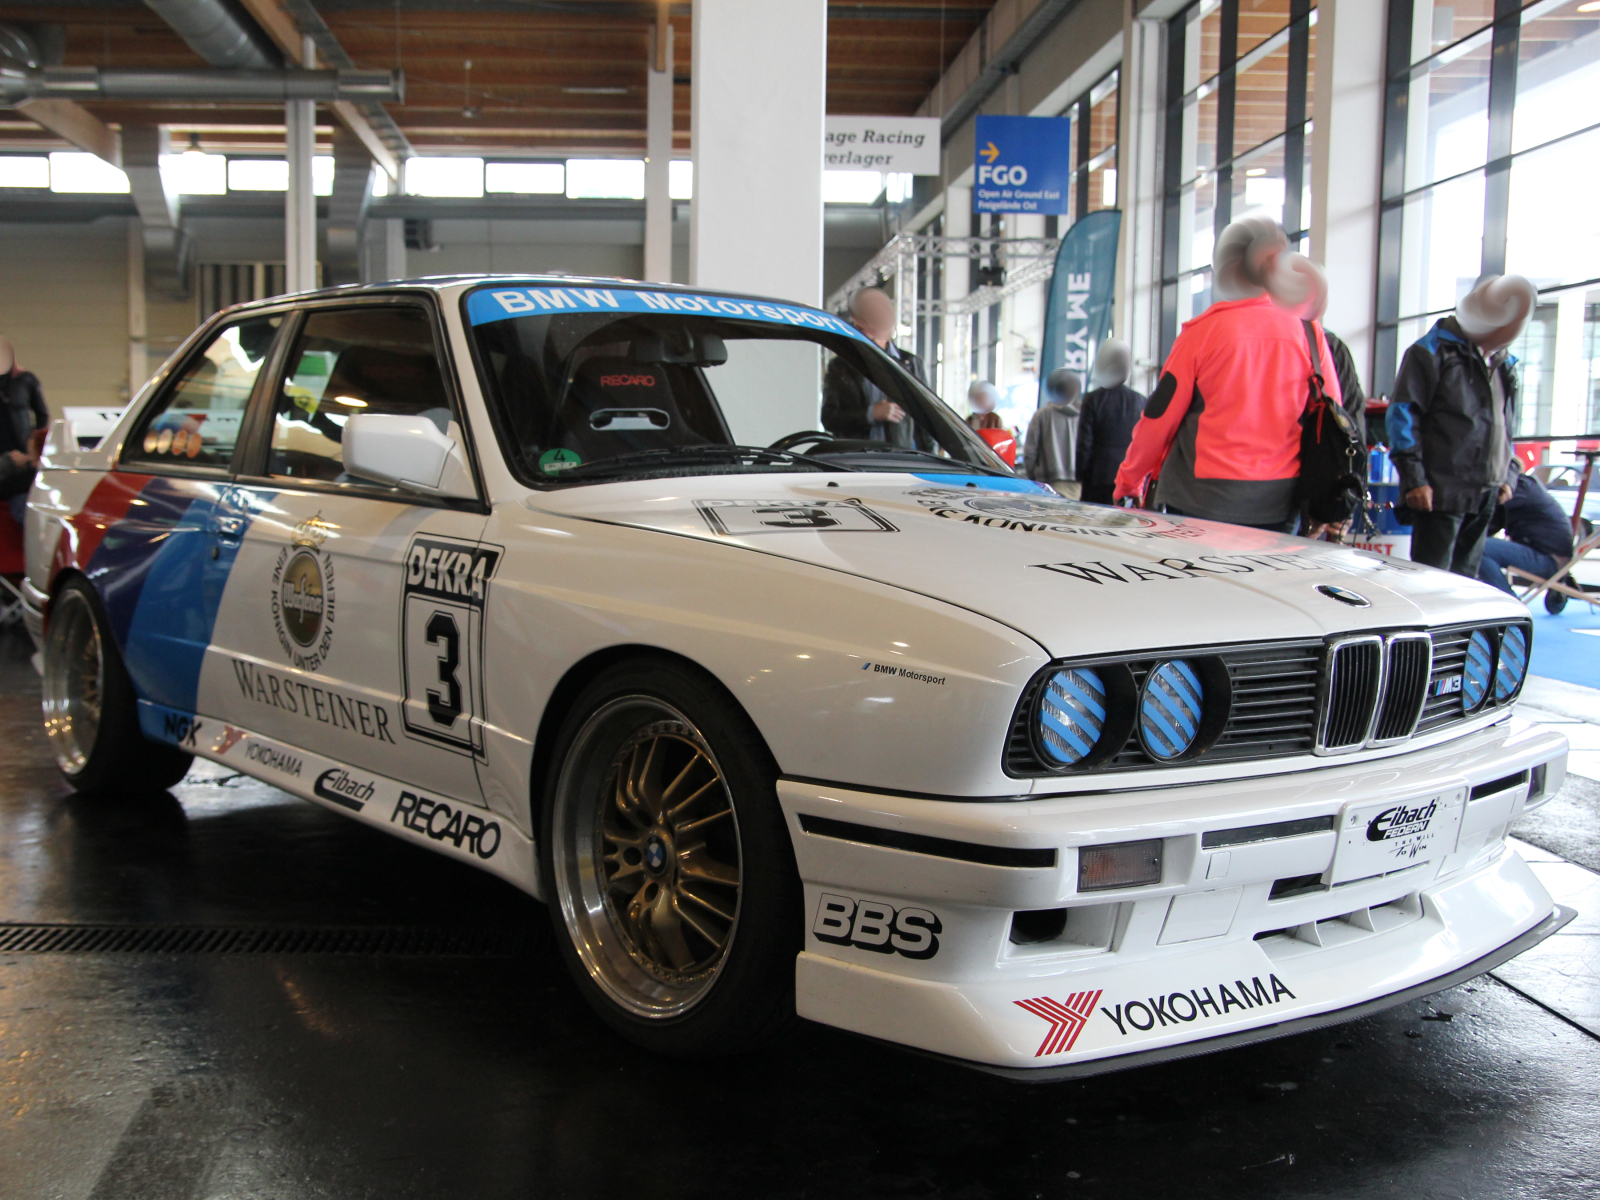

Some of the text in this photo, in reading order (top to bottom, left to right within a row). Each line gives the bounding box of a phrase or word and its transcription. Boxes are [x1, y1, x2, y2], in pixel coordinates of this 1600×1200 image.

[862, 128, 925, 148] Racing
[978, 165, 1028, 186] FGO
[978, 189, 1060, 200] Open Air Ground East
[1022, 201, 1037, 210] Ost
[491, 289, 854, 335] BMW Motorsport
[600, 374, 656, 387] RECARO
[553, 449, 566, 462] 4
[752, 508, 842, 528] 3
[407, 545, 488, 600] DEKRA
[424, 609, 463, 731] 3
[873, 664, 946, 685] BMW Motorsport
[231, 658, 397, 746] WARSTEINER
[164, 712, 202, 748] NGK
[245, 741, 303, 778] YOKOHAMA
[313, 768, 375, 812] Eibach
[391, 790, 501, 860] RECARO
[1366, 799, 1437, 841] Eibach
[1383, 820, 1428, 839] FEDERN
[812, 893, 943, 960] BBS
[1100, 973, 1297, 1036] YOKOHAMA
